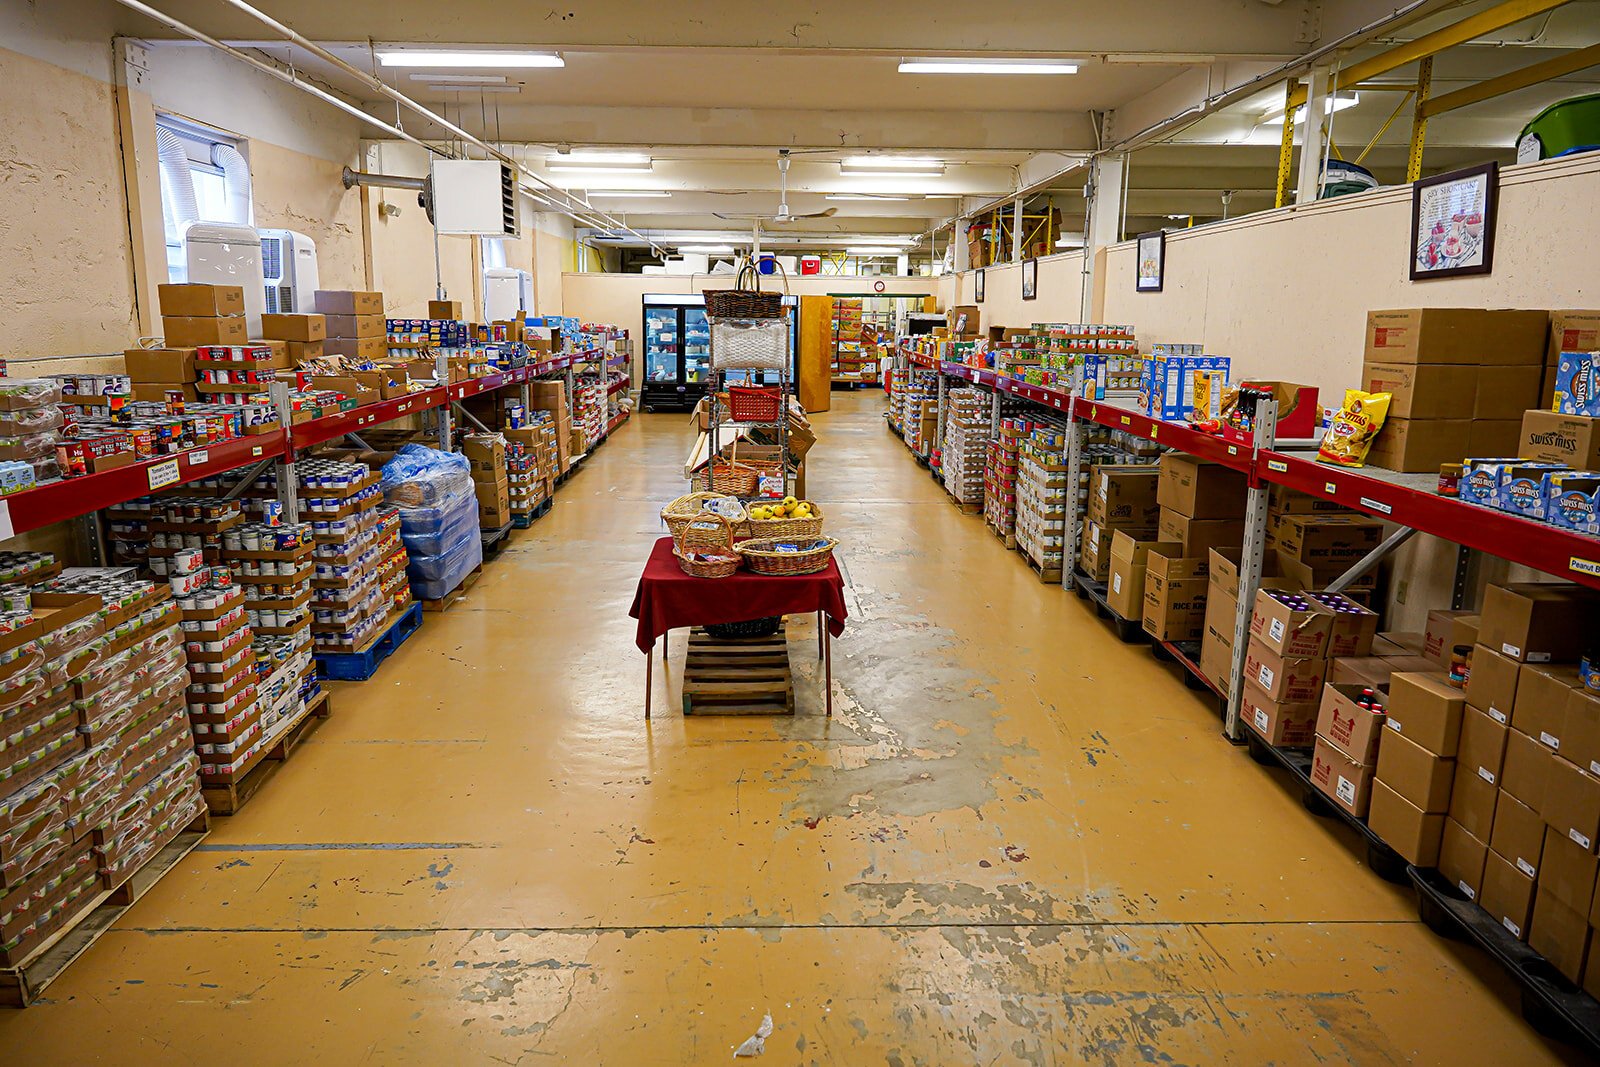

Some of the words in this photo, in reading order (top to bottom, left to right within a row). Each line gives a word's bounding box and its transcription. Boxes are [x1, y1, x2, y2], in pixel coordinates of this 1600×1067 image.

[1440, 179, 1478, 194] SHORTCAKE
[1580, 360, 1591, 382] MISS
[1575, 383, 1587, 409] SWISS
[1529, 433, 1554, 446] SWISS
[1554, 436, 1577, 452] MISS
[1469, 476, 1483, 485] SWISS
[1483, 478, 1496, 489] MISS
[1509, 485, 1526, 494] SWISS
[1526, 487, 1540, 499] MISS
[1559, 497, 1578, 508] SWISS
[1578, 501, 1594, 513] MISS
[1571, 560, 1594, 572] Peanut
[1173, 602, 1191, 610] RICE
